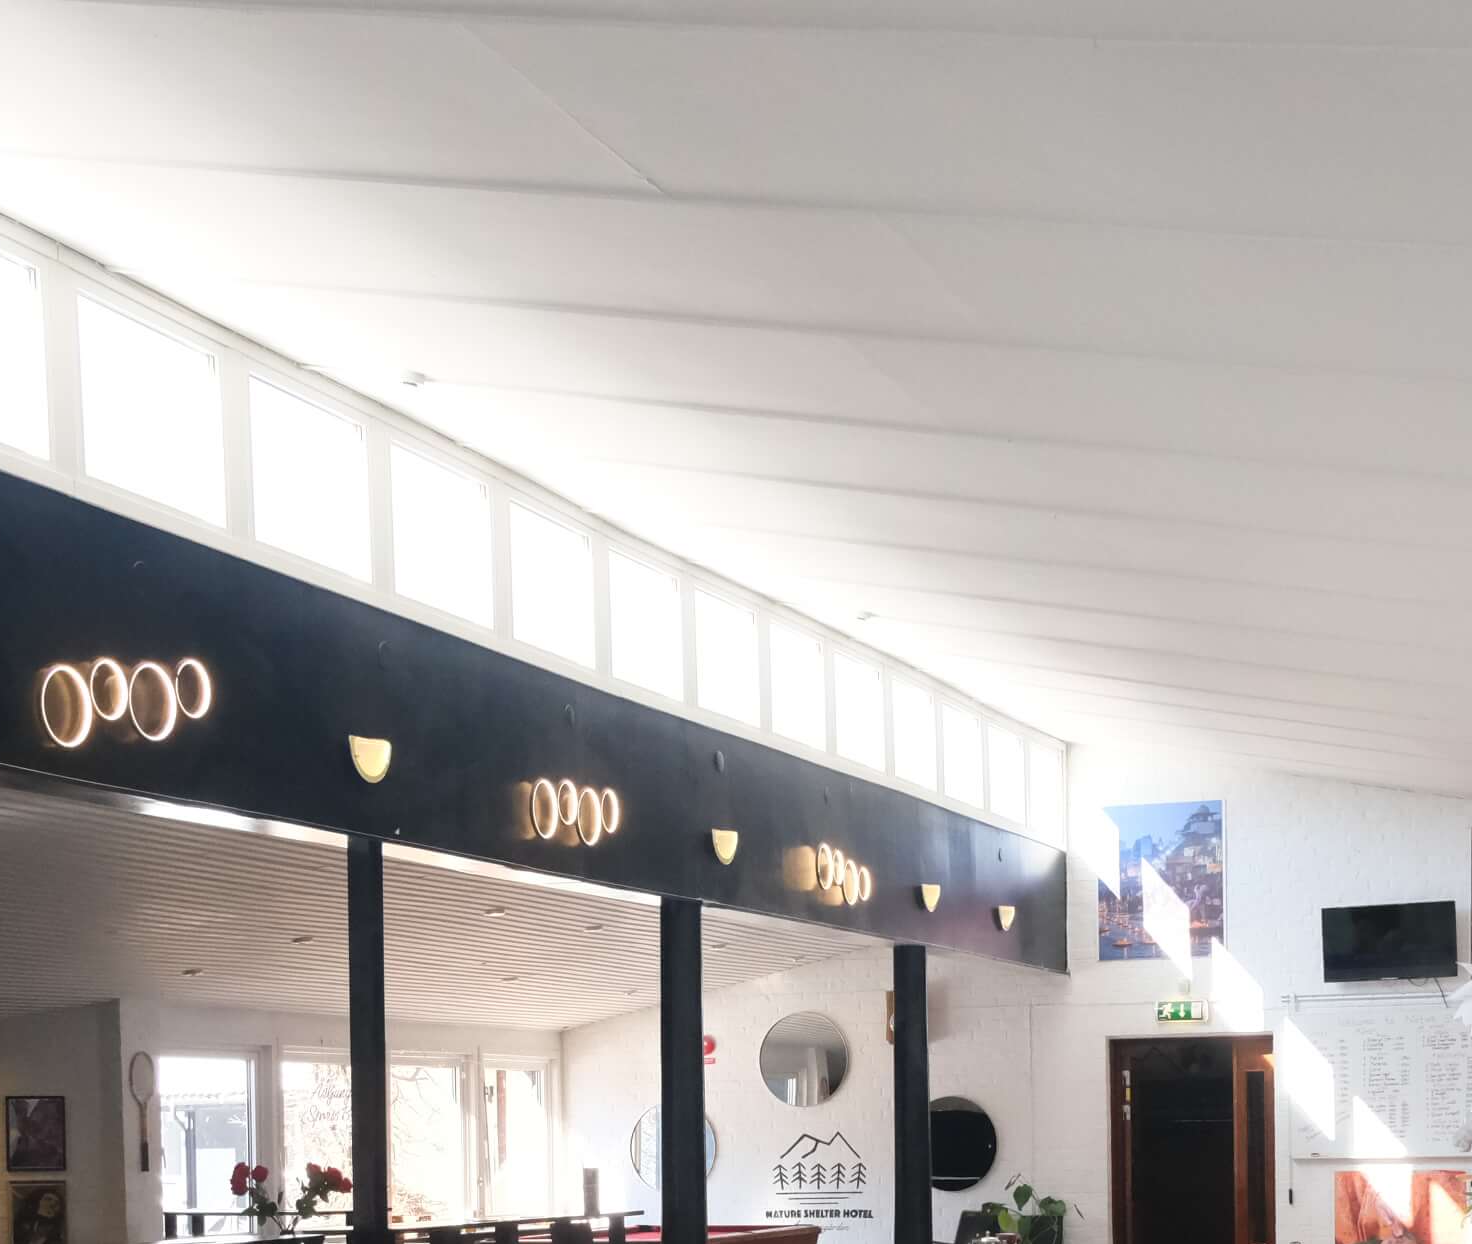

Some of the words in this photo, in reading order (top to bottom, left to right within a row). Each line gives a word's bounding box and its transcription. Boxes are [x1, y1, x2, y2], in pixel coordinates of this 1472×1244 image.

[765, 1210, 802, 1219] NATURE
[803, 1209, 841, 1219] SHELTER
[842, 1209, 874, 1219] HOTEL
